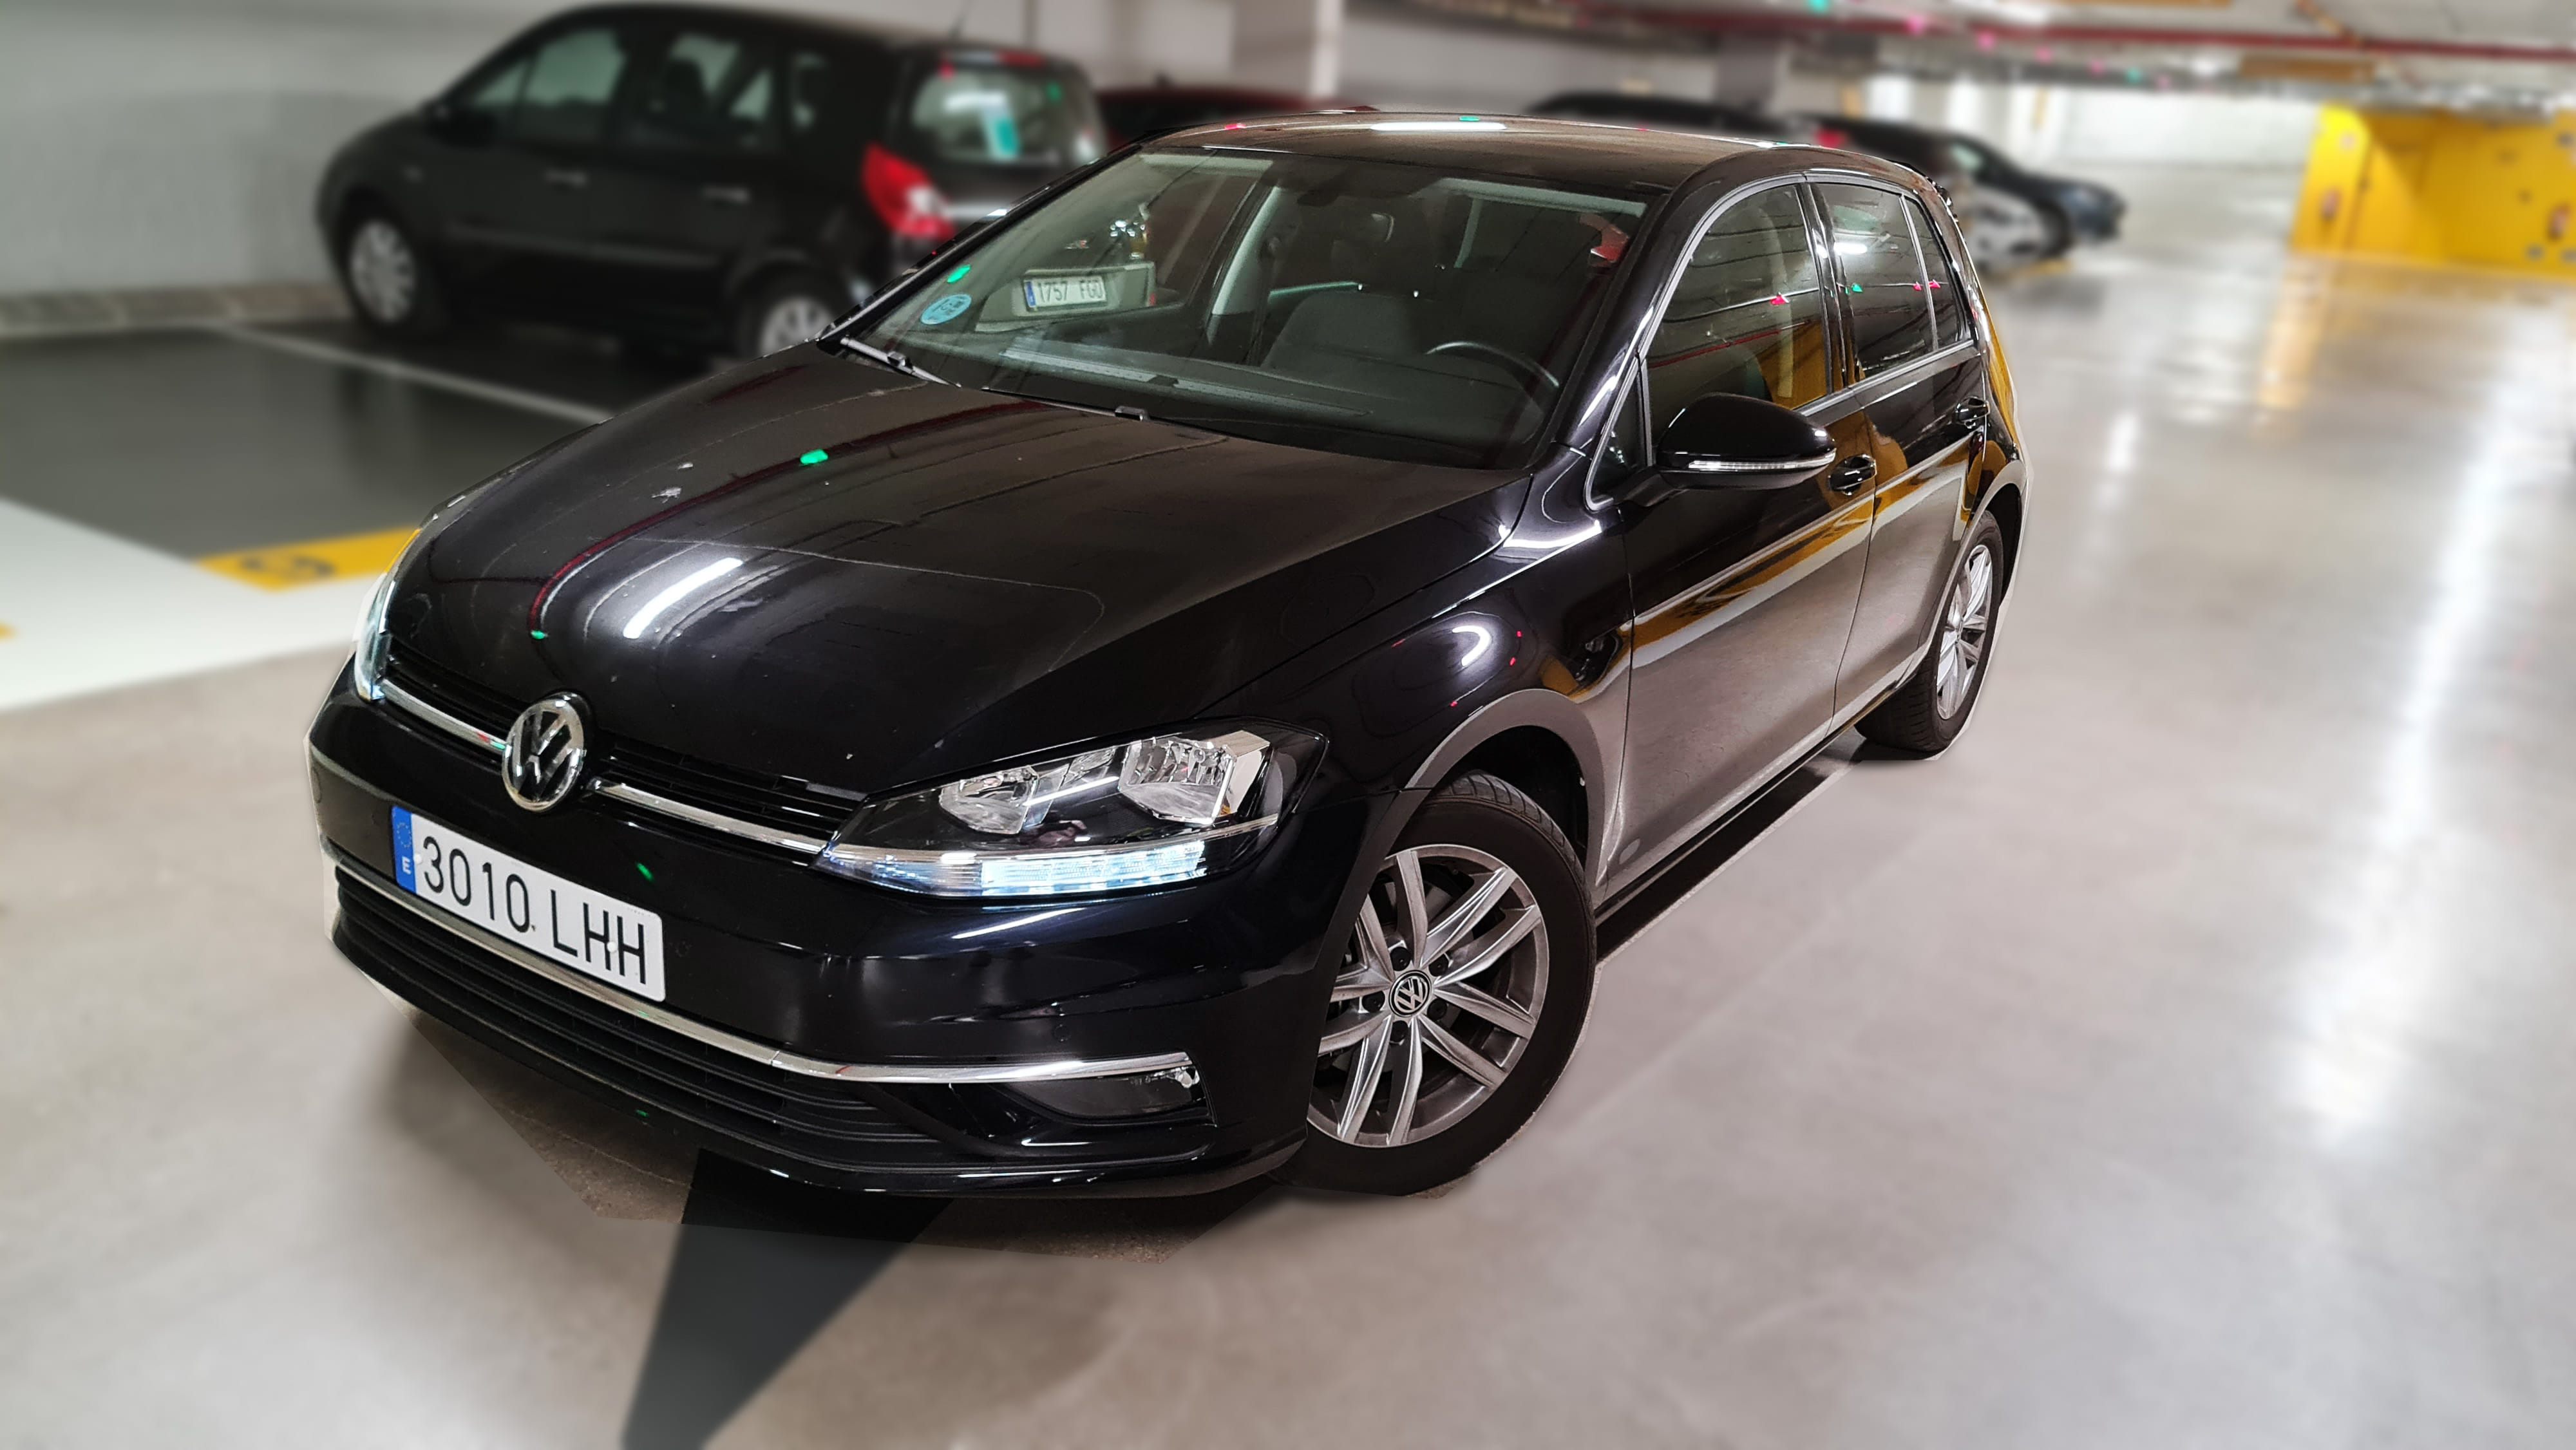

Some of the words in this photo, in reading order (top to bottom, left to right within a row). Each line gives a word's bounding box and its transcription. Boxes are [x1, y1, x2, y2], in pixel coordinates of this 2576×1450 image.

[1037, 280, 1068, 303] 1757
[402, 856, 412, 875] E
[423, 836, 530, 933] 3010
[551, 889, 646, 984] LHH
